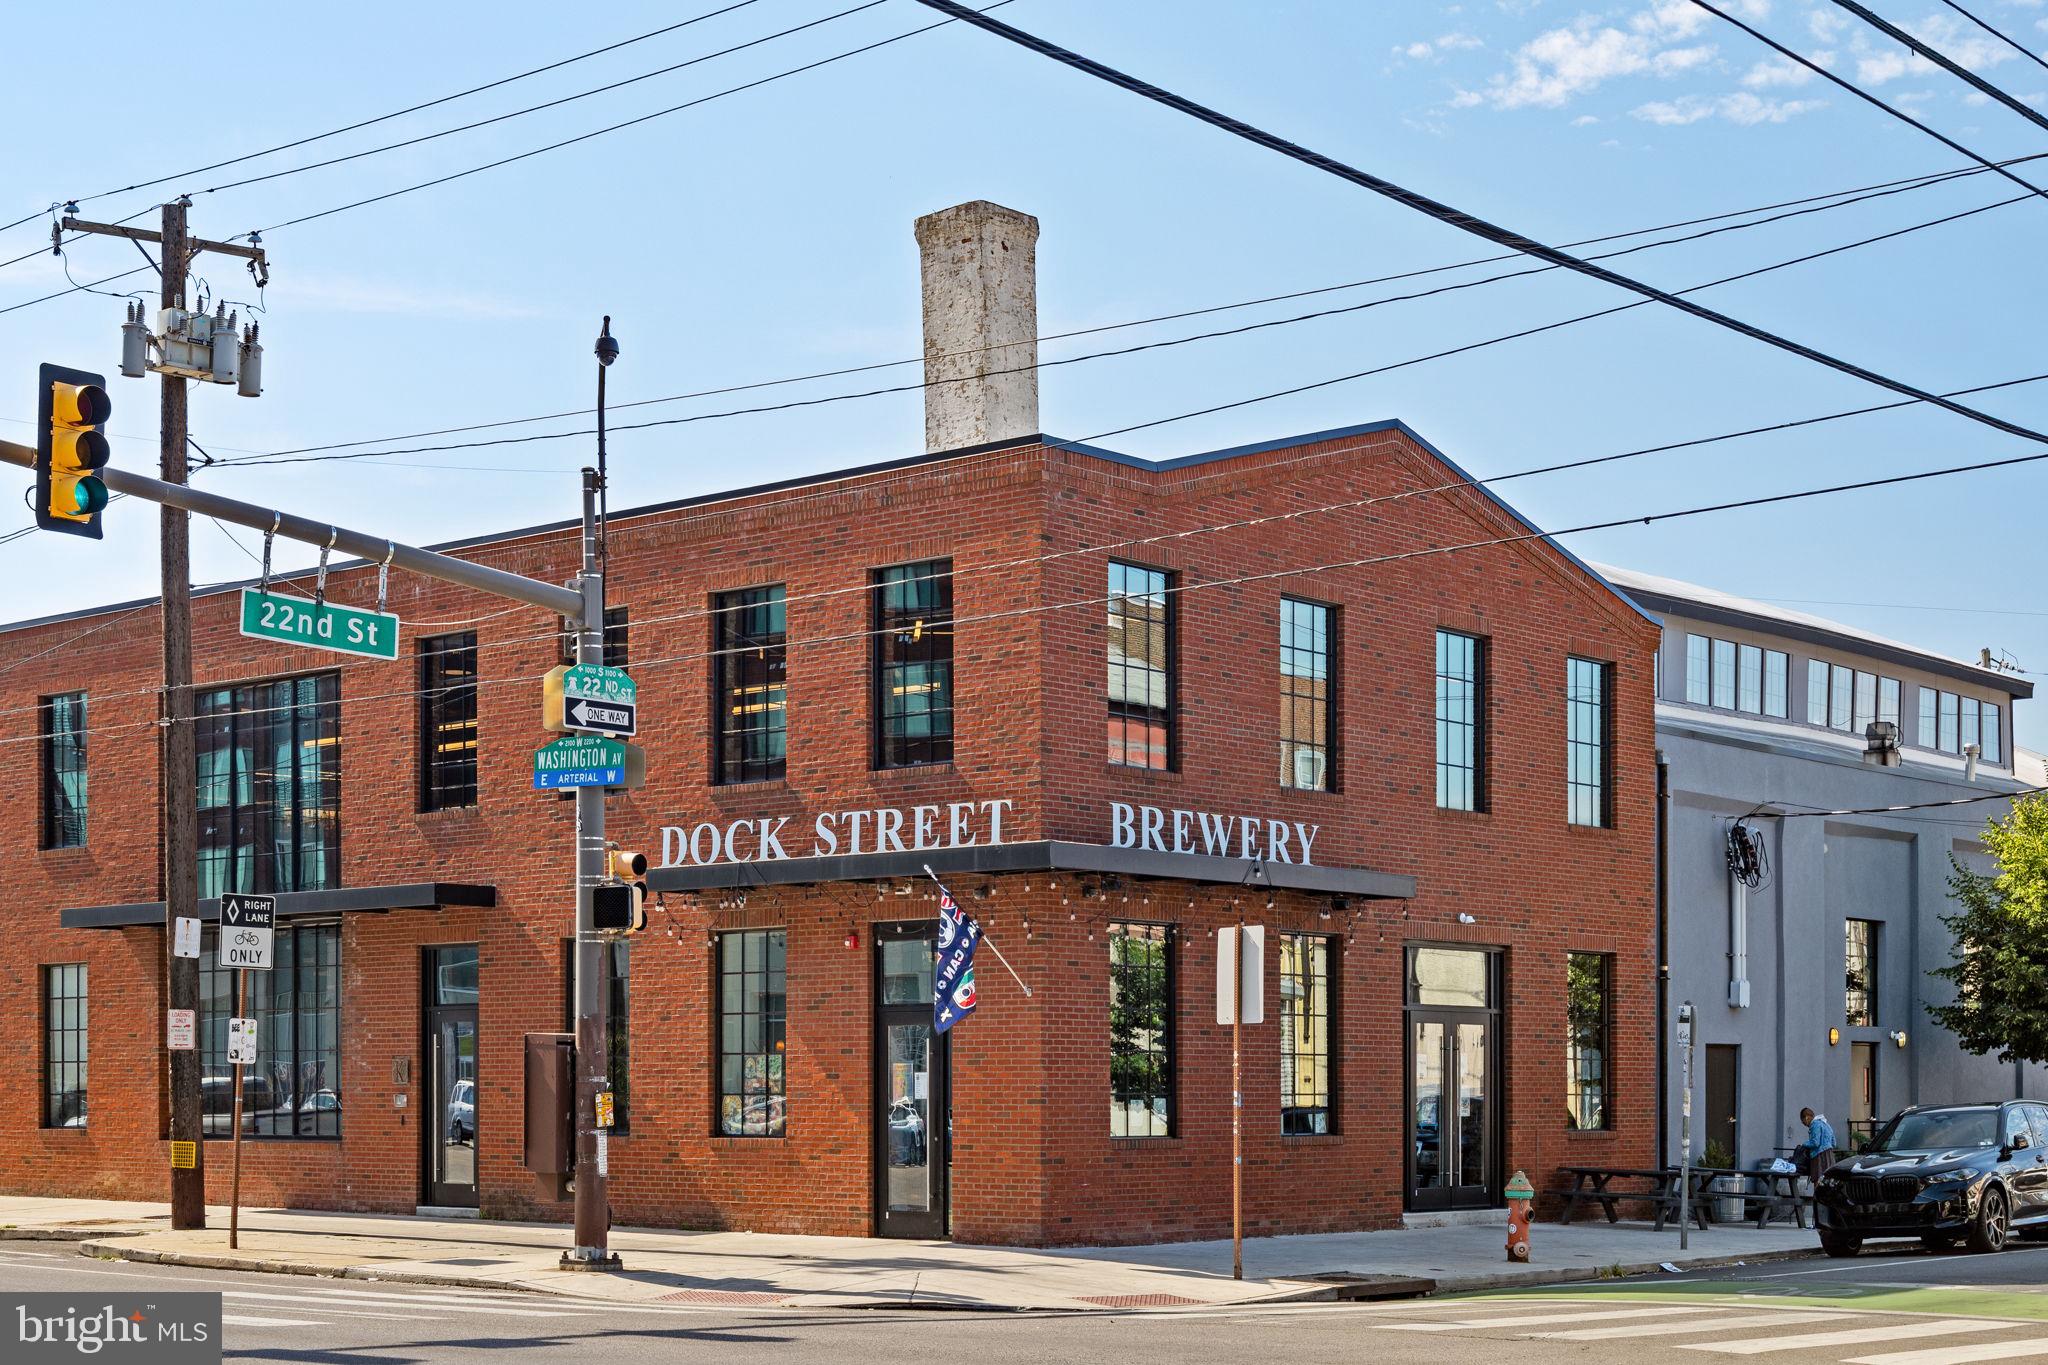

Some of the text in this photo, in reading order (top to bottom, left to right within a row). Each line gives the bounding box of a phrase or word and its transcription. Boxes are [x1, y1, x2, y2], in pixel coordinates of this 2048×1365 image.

[260, 602, 379, 646] 22nd St
[598, 667, 604, 677] S
[605, 669, 617, 678] 1100
[583, 677, 632, 701] 22 ND ST
[587, 708, 626, 724] ONE WAY
[576, 737, 583, 747] W
[538, 748, 621, 769] WASHINGTON AV
[540, 769, 616, 786] E ARTERIAL W
[659, 799, 1320, 869] DOCK STREET BREWERY
[244, 900, 272, 911] RIGHT
[245, 912, 270, 923] LANE
[230, 948, 263, 964] ONLY
